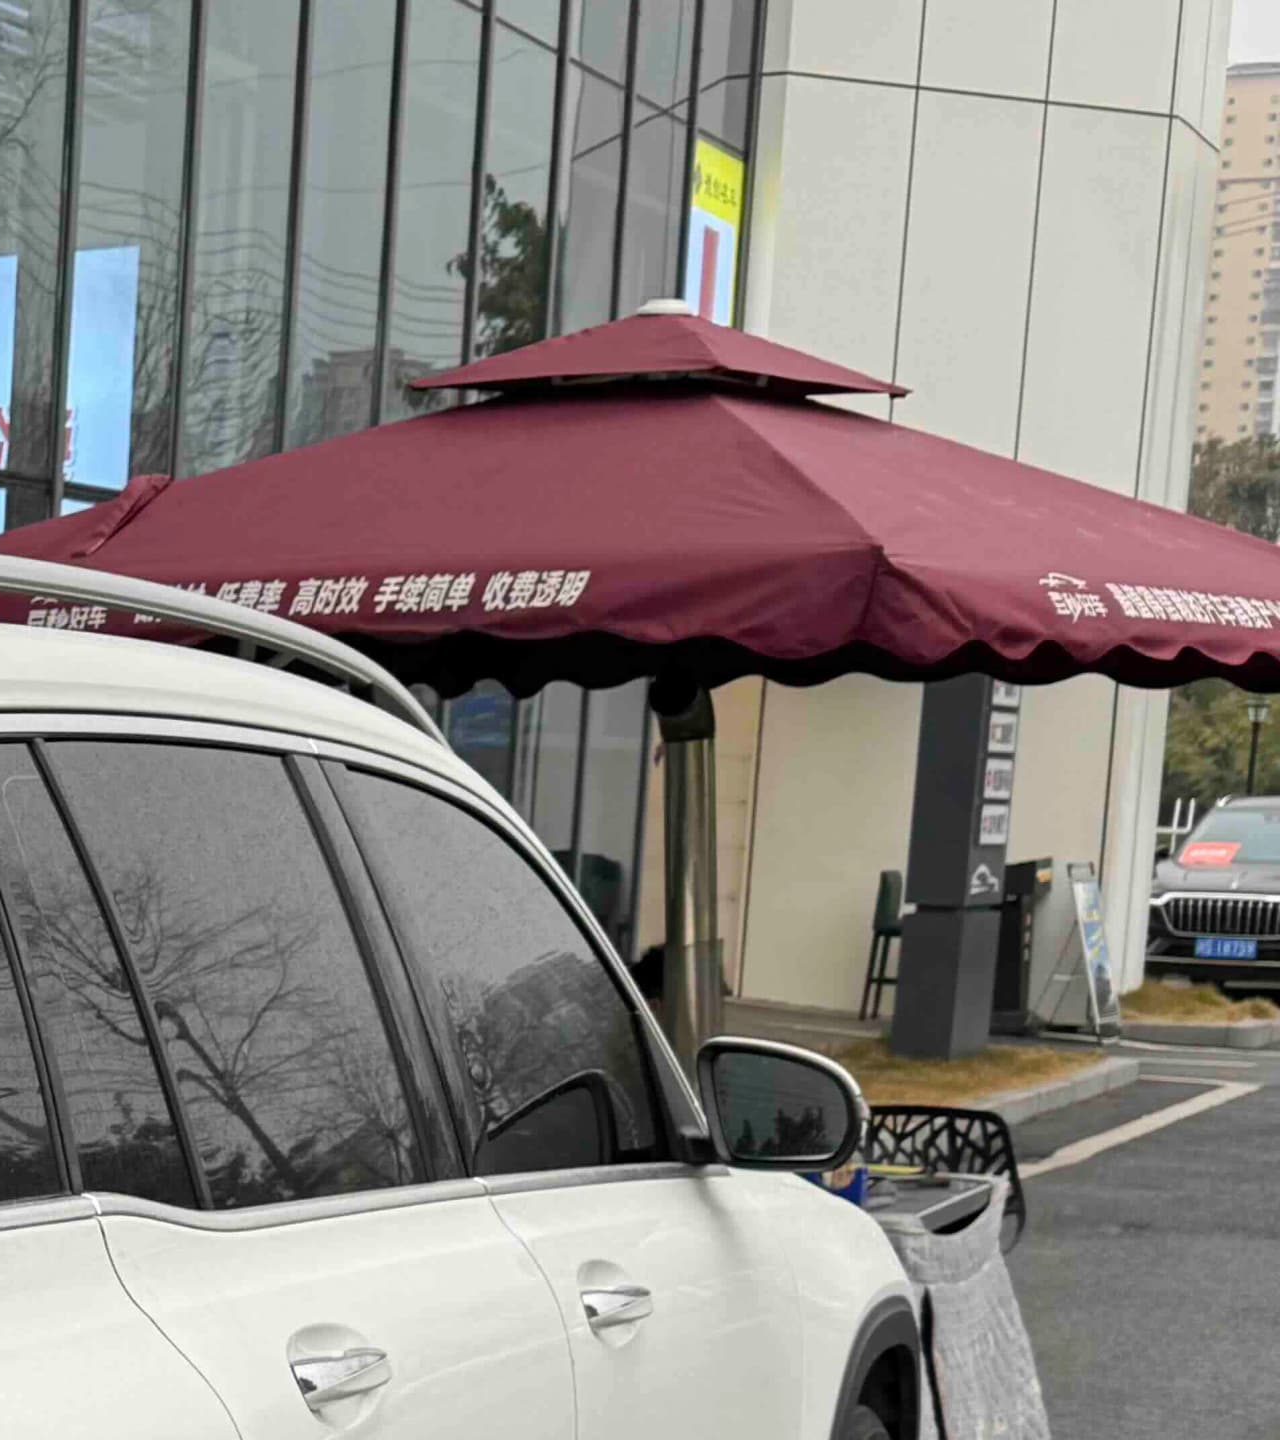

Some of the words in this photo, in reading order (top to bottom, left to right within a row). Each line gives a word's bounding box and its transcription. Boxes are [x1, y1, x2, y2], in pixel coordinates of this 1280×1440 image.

[289, 577, 369, 616] 高时效
[373, 573, 476, 614] 手续简单
[482, 570, 591, 611] 收费透明
